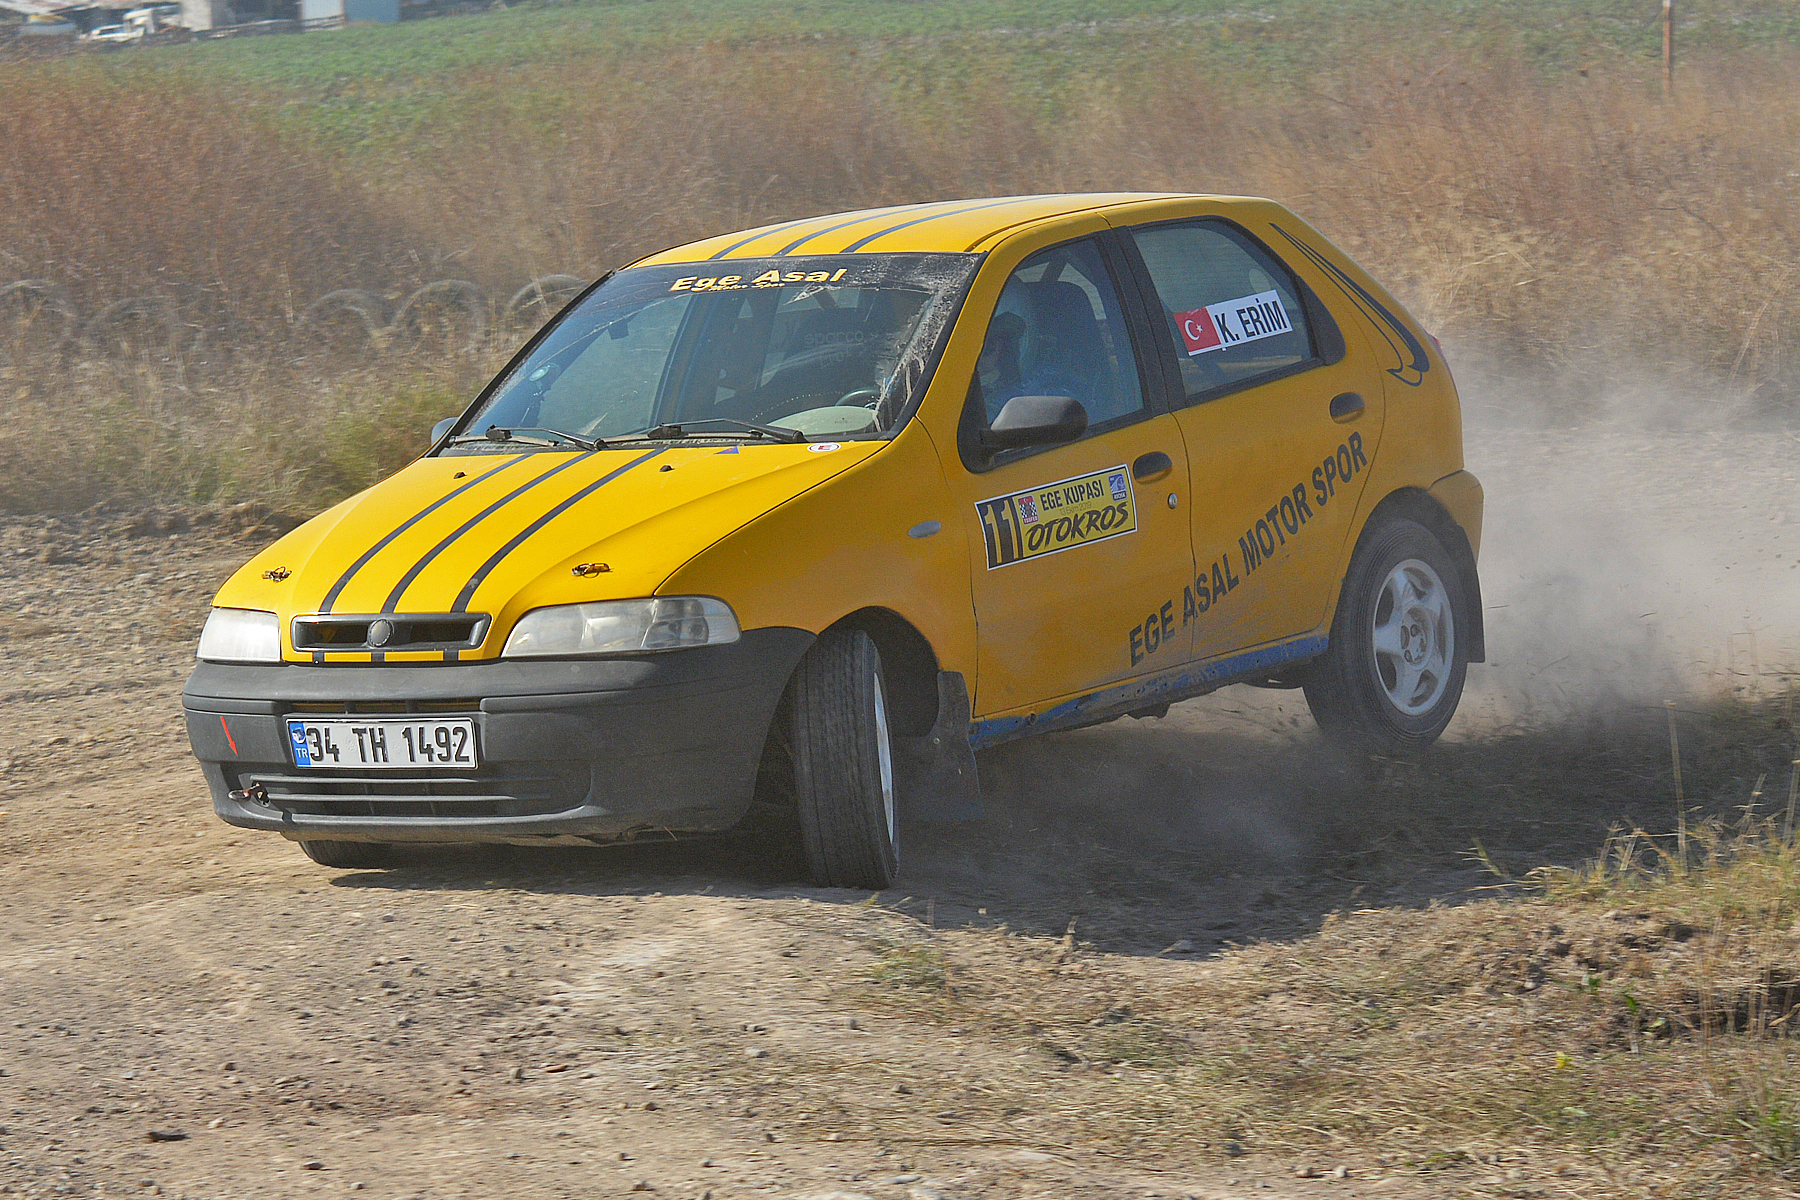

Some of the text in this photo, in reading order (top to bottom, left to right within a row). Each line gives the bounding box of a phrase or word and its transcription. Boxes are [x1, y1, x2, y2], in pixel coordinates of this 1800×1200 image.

[670, 268, 848, 291] Ege Asal
[1214, 298, 1288, 344] K. ERİM
[1040, 490, 1065, 511] EGE
[1064, 479, 1105, 505] KUPASI
[984, 499, 1019, 564] 11
[1026, 502, 1129, 551] OTOKROS
[1129, 431, 1368, 668] EGE ASAL MOTOR SPOR
[296, 749, 308, 758] TR
[306, 726, 470, 764] 34 TH 1492
